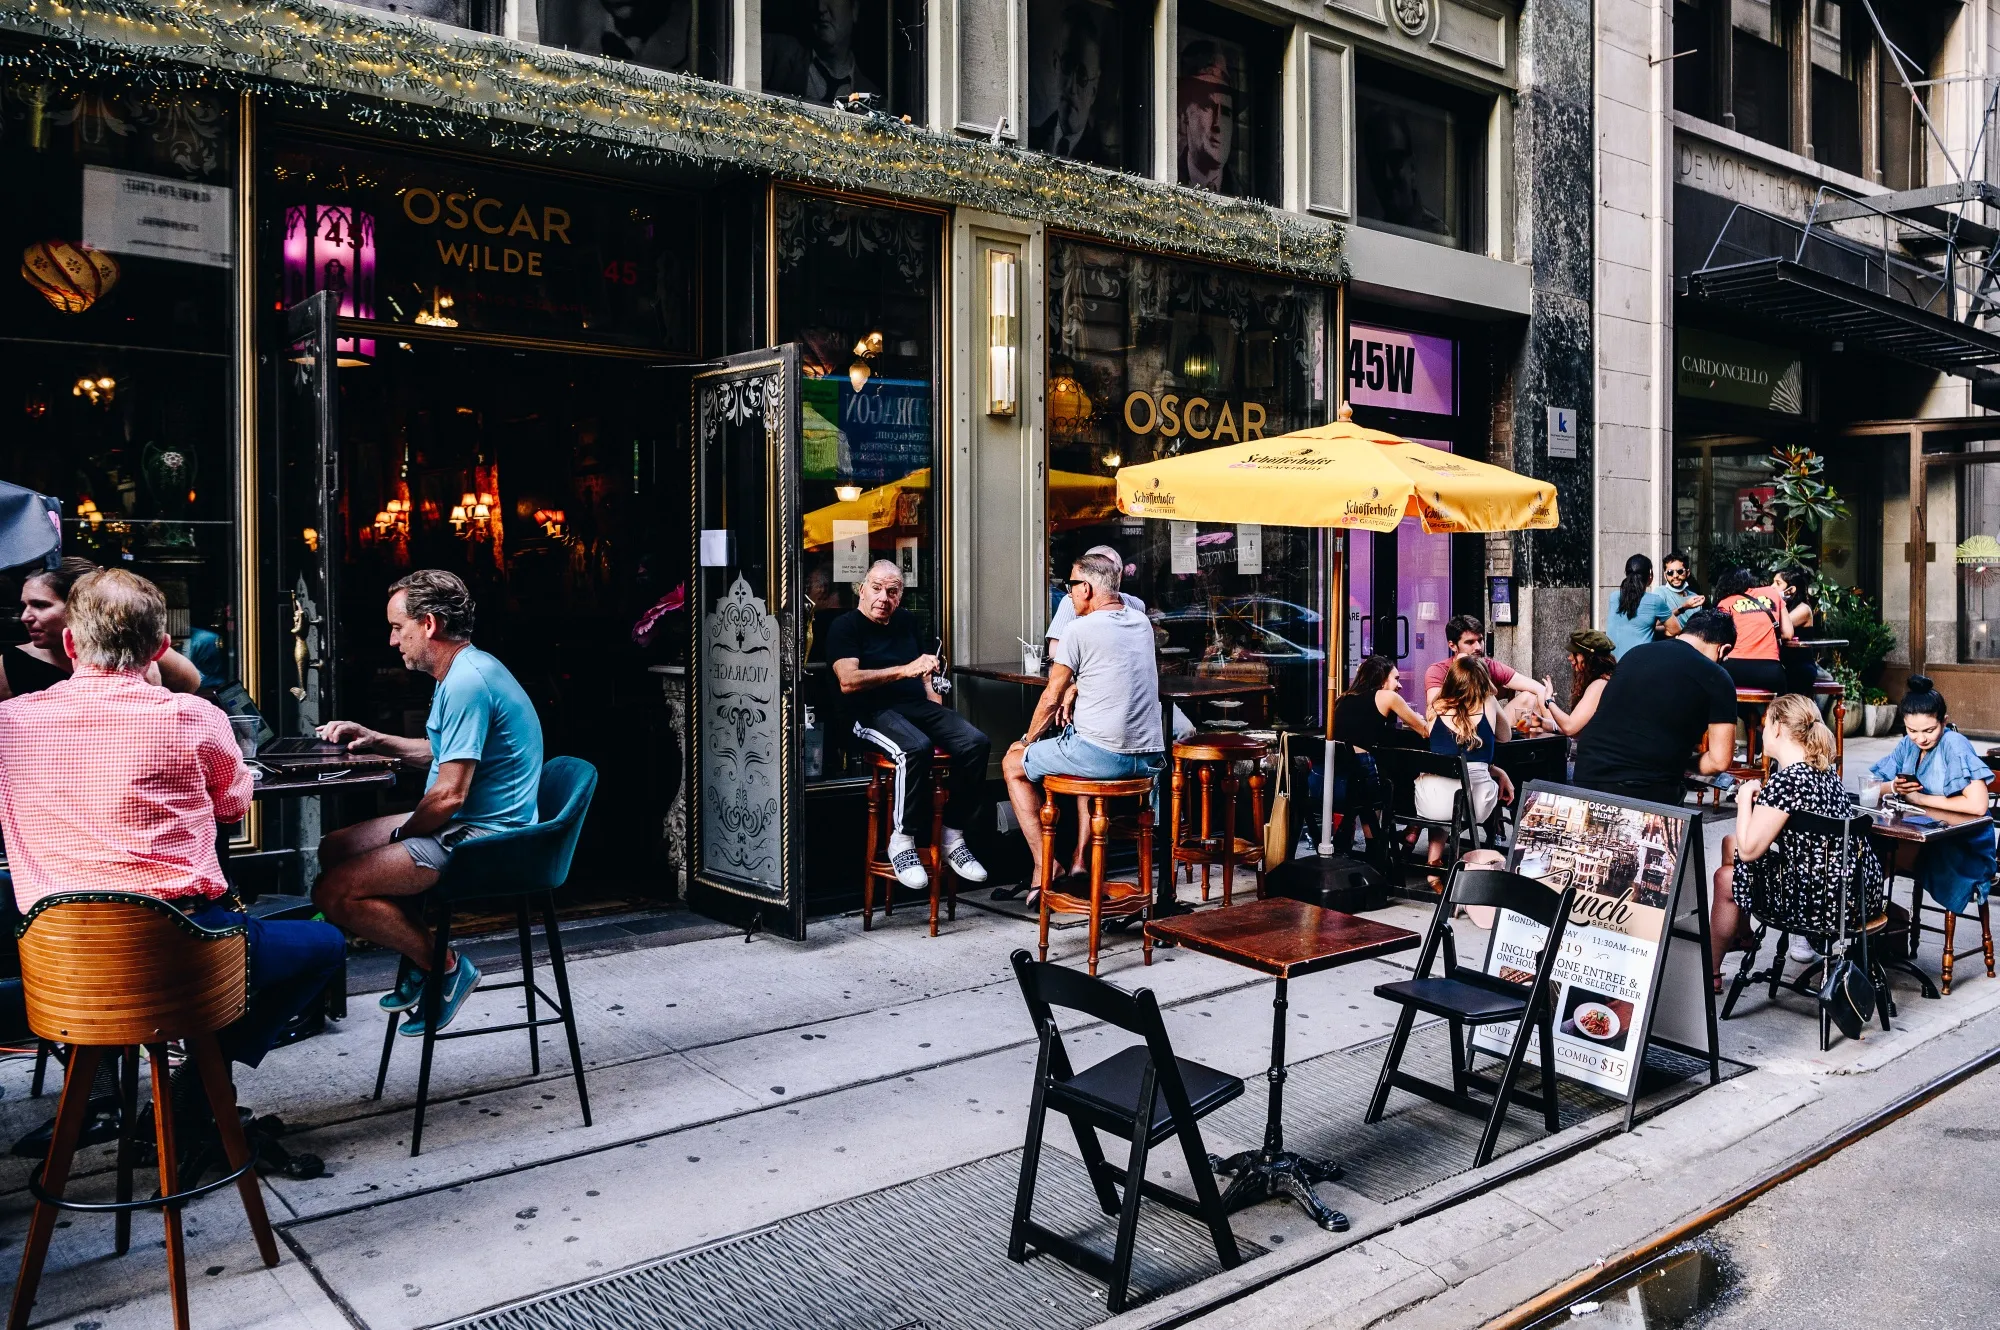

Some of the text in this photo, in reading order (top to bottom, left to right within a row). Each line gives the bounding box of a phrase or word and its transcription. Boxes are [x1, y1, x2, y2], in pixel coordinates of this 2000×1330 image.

[403, 188, 572, 245] OSCAR
[325, 221, 365, 250] 45
[436, 239, 543, 277] WILDE
[603, 260, 637, 285] 45
[1349, 338, 1415, 394] 45W
[1681, 355, 1768, 385] CARDONCELLO
[1124, 390, 1267, 442] OSCAR
[1343, 499, 1399, 518] Schöfferhofer
[1588, 801, 1619, 815] OSCAR
[1507, 913, 1541, 929] MONDAY
[1591, 919, 1629, 935] SPECIAL
[1496, 952, 1514, 964] ONE
[1570, 973, 1583, 984] OR
[1584, 977, 1618, 993] SELECT
[1619, 986, 1641, 1000] BEER
[1556, 958, 1581, 973] ONE
[1582, 964, 1627, 986] ENTREE
[1629, 978, 1638, 989] &
[1483, 1023, 1511, 1037] SOUP
[1557, 1046, 1597, 1066] COMBO
[1600, 1057, 1625, 1077] $15
